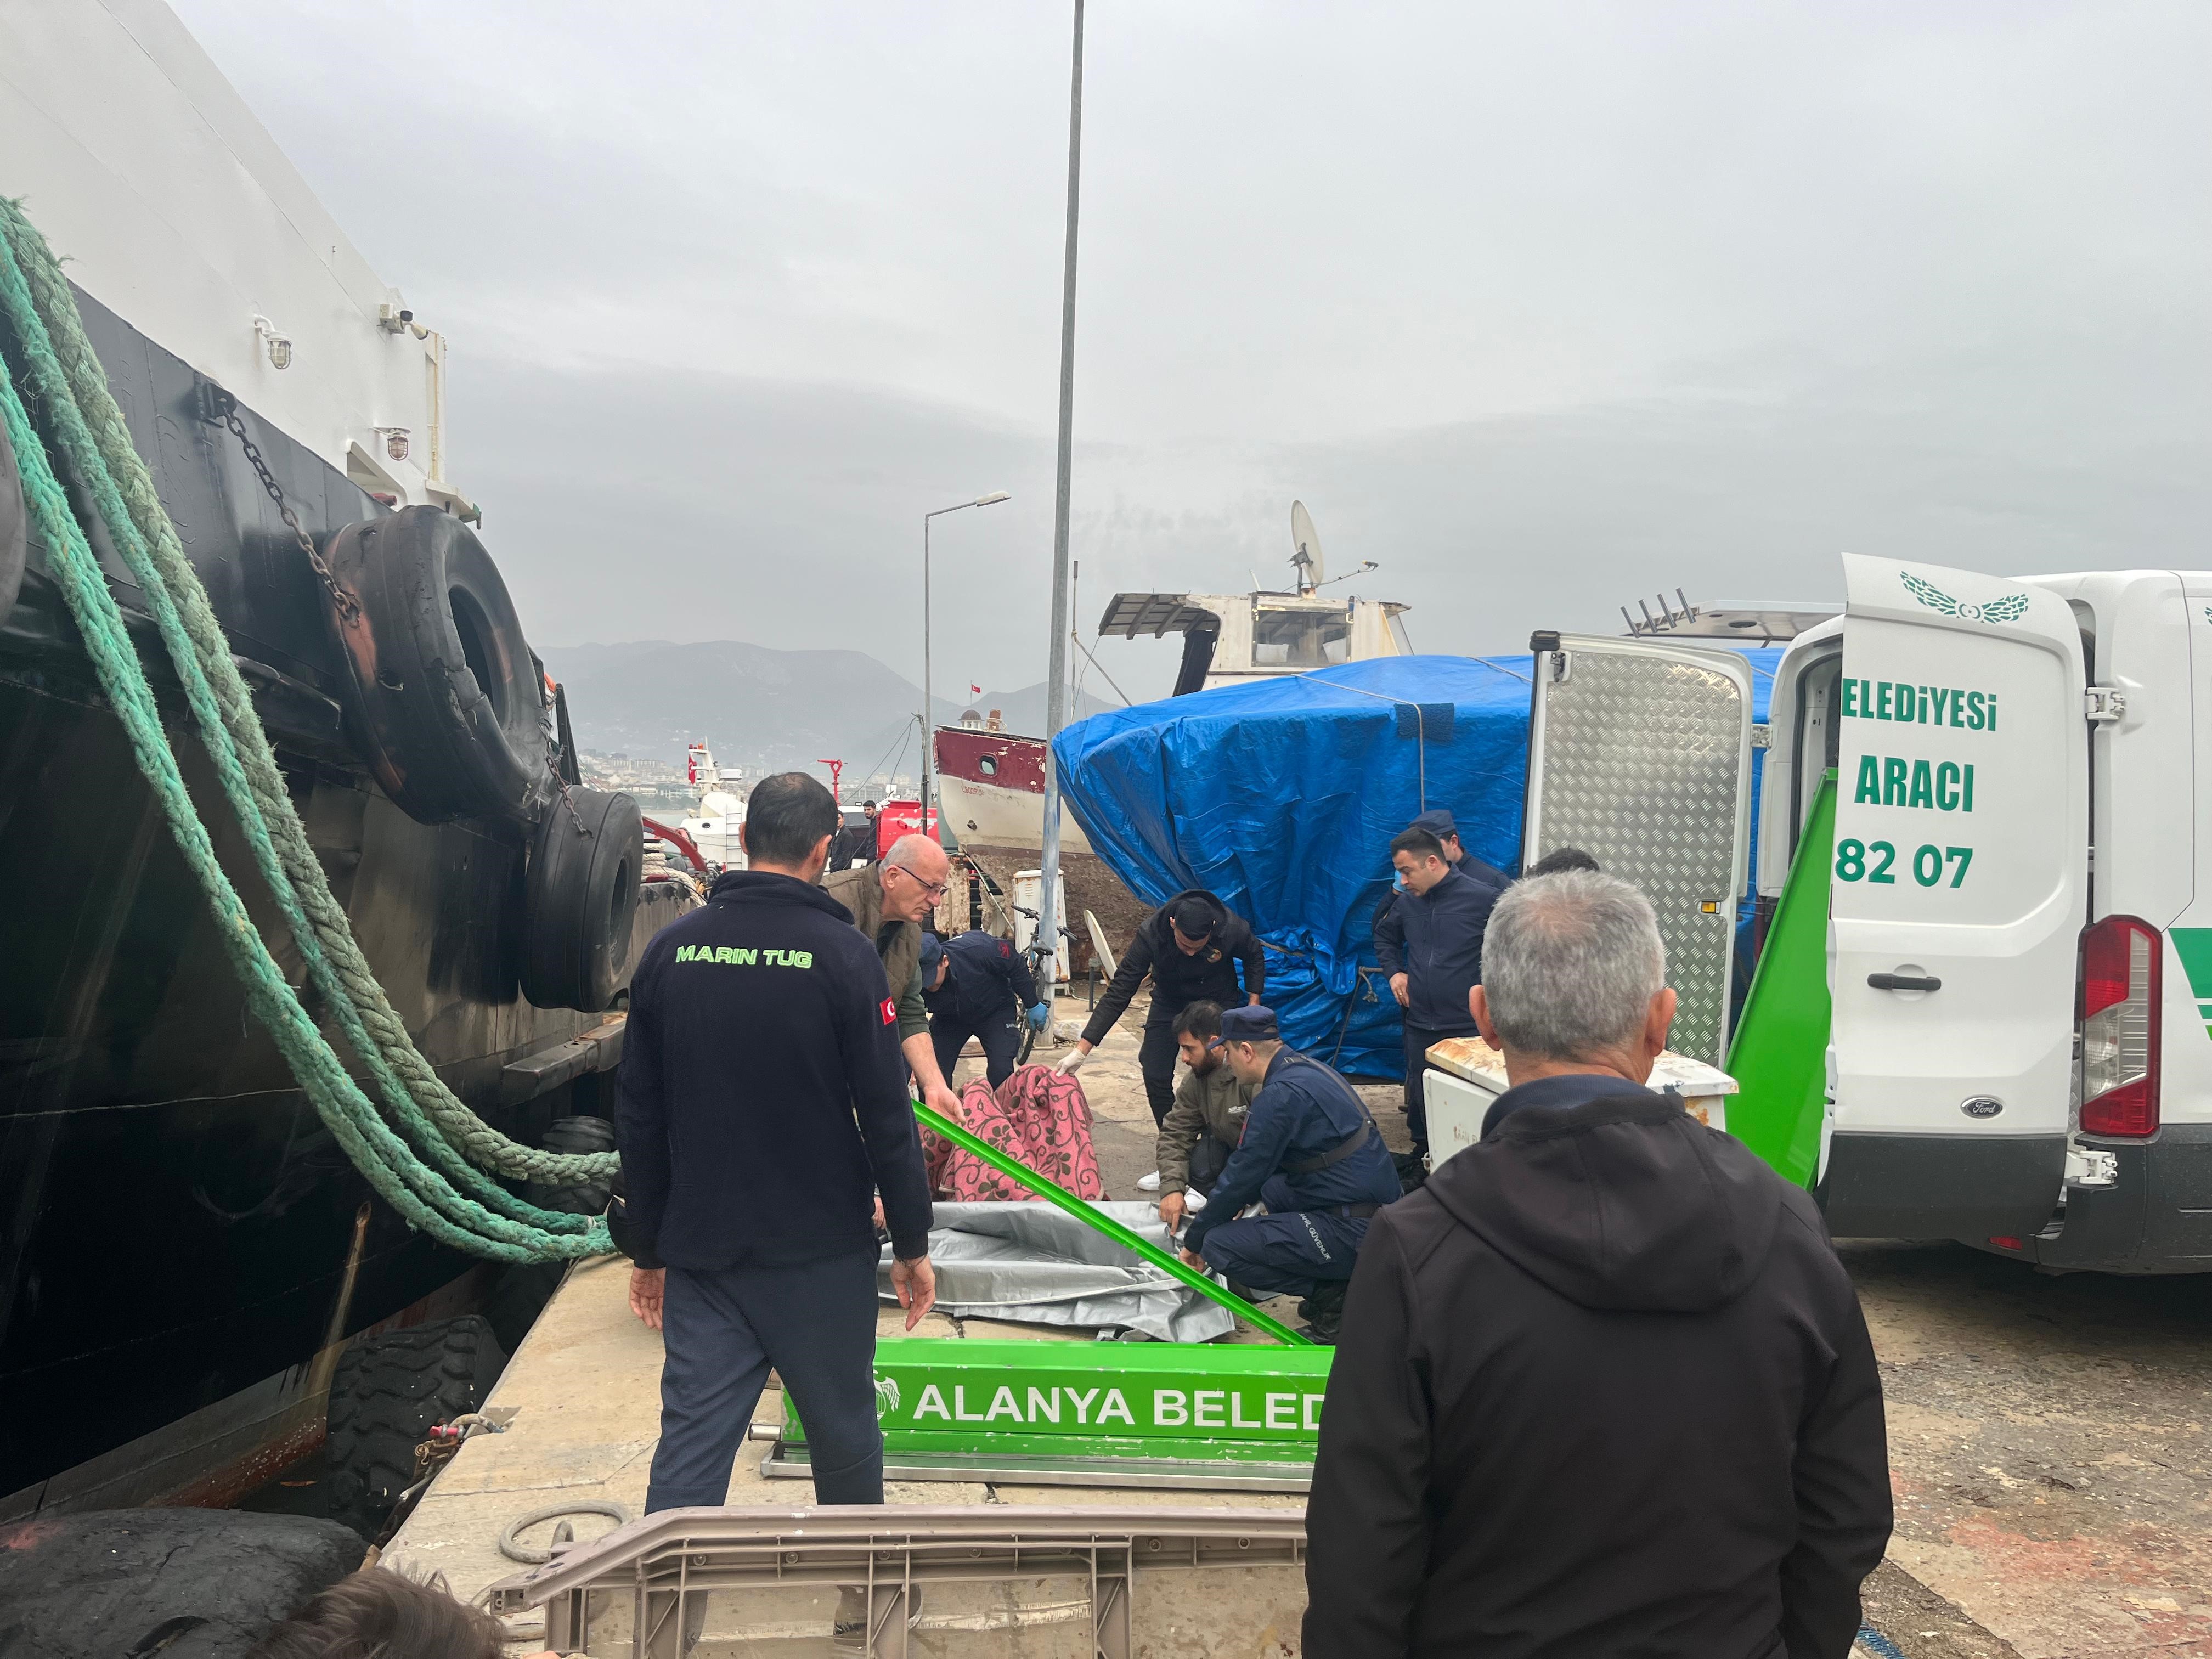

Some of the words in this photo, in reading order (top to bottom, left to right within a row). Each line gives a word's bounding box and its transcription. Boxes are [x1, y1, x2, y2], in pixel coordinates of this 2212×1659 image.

[1854, 755, 1974, 812] ARACI
[1835, 838, 1895, 884] 82
[1912, 844, 1973, 888] 07
[675, 945, 758, 965] MARIN
[763, 950, 813, 968] TUG
[1973, 1101, 1996, 1113] Ford
[912, 1384, 1135, 1425] ALANYA
